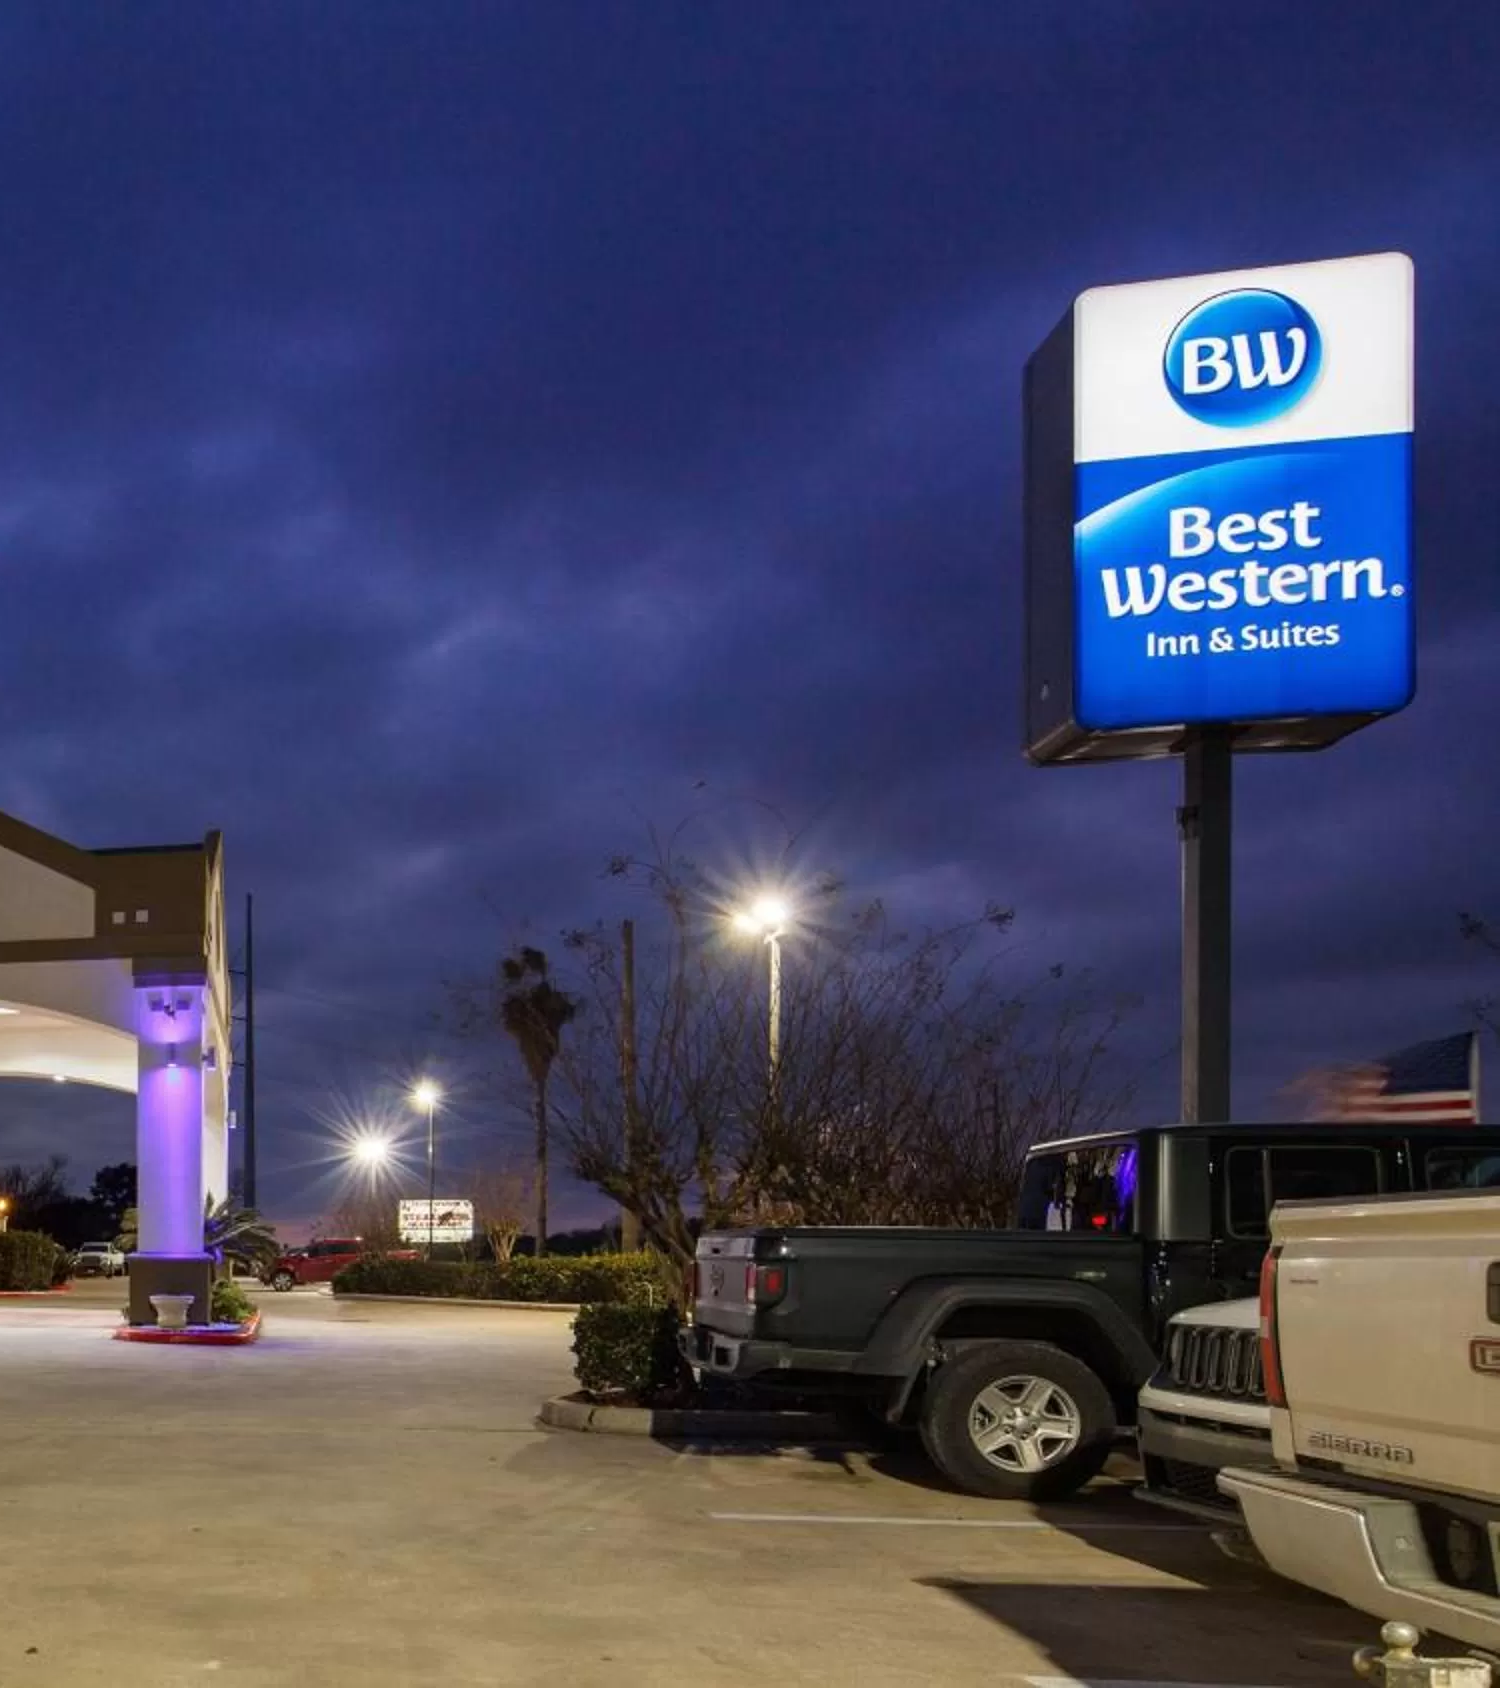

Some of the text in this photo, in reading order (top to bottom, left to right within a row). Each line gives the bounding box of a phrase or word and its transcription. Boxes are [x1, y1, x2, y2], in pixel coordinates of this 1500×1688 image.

[1182, 326, 1308, 396] BW
[1168, 501, 1322, 558] Best
[1101, 556, 1387, 619] Western
[1146, 622, 1341, 658] Inn & Suites
